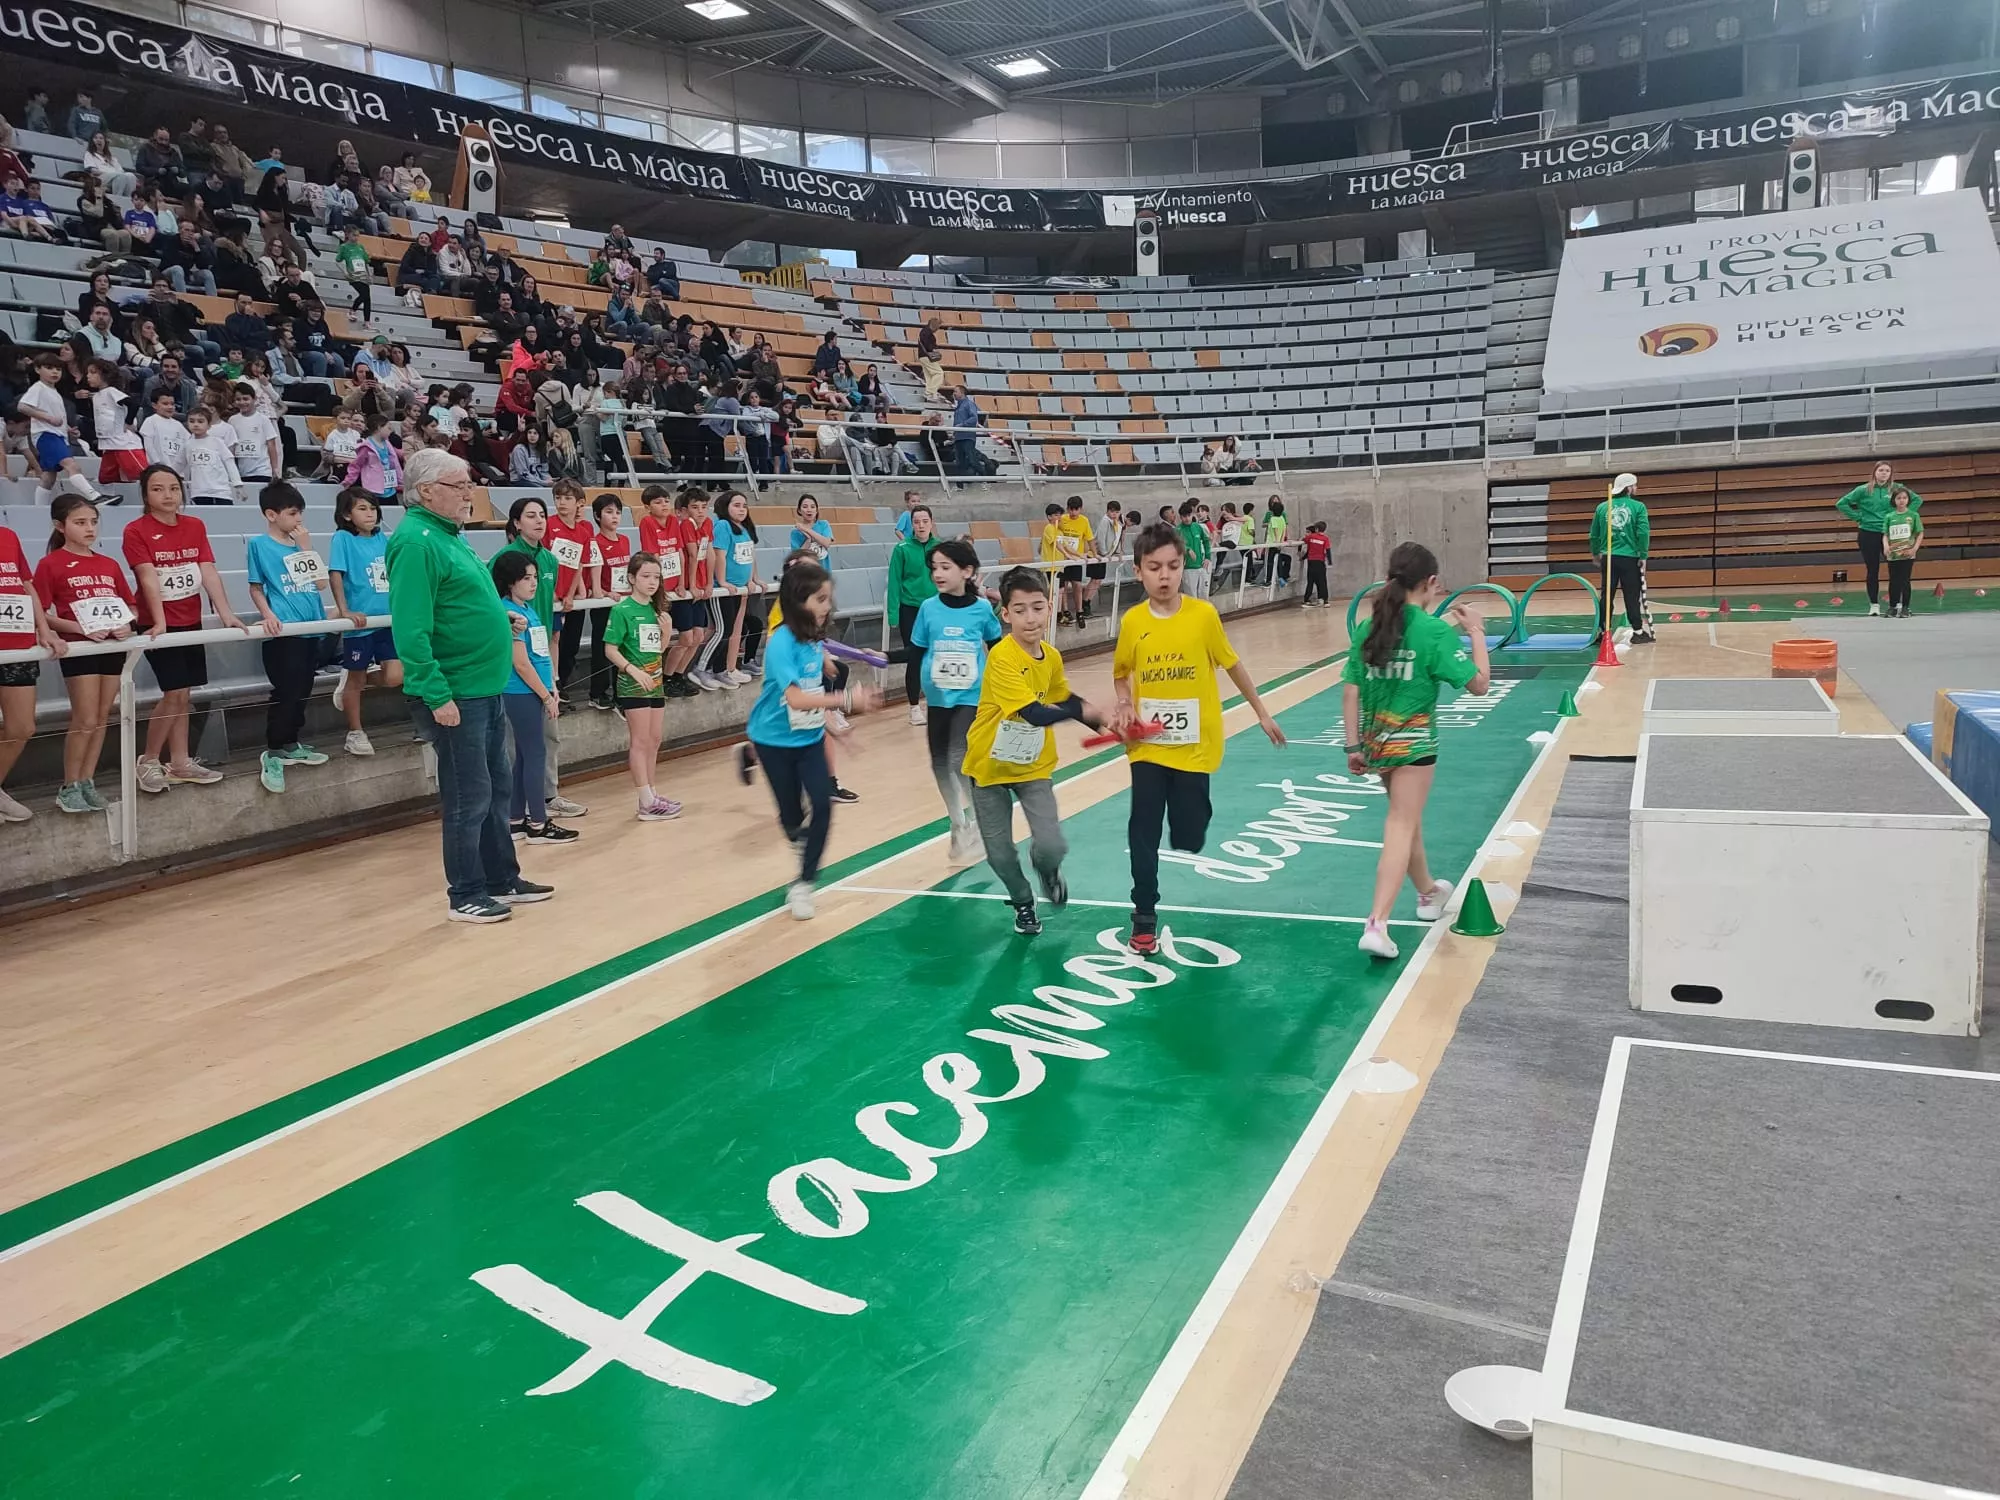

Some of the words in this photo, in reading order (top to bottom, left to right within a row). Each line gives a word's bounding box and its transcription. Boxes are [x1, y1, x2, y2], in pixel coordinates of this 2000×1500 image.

[0, 4, 173, 74] uesca
[1693, 108, 1851, 151] Huesca
[583, 142, 628, 173] La
[1519, 131, 1650, 170] Huesca
[758, 164, 865, 202] Huesca
[1347, 162, 1468, 196] Huesca
[1542, 172, 1563, 184] La
[785, 197, 804, 210] La
[906, 188, 1015, 214] Huesca
[1143, 190, 1253, 211] Ayuntamiento
[1370, 197, 1390, 210] La
[928, 215, 948, 227] La
[1167, 209, 1228, 226] Huesca
[1597, 231, 1945, 293] Huesca
[1640, 284, 1700, 307] La
[1737, 305, 1906, 332] DIPUTACIÓN
[1737, 317, 1907, 343] HUESCA
[240, 444, 256, 452] 142
[192, 453, 211, 462] 145
[558, 546, 579, 560] 433
[293, 558, 318, 575] 408
[663, 560, 677, 570] 436
[67, 575, 94, 588] PEDRO
[164, 574, 194, 590] 438
[92, 605, 123, 620] 445
[939, 663, 971, 678] 400
[1150, 711, 1189, 730] 425
[468, 924, 1242, 1408] Hacemos
